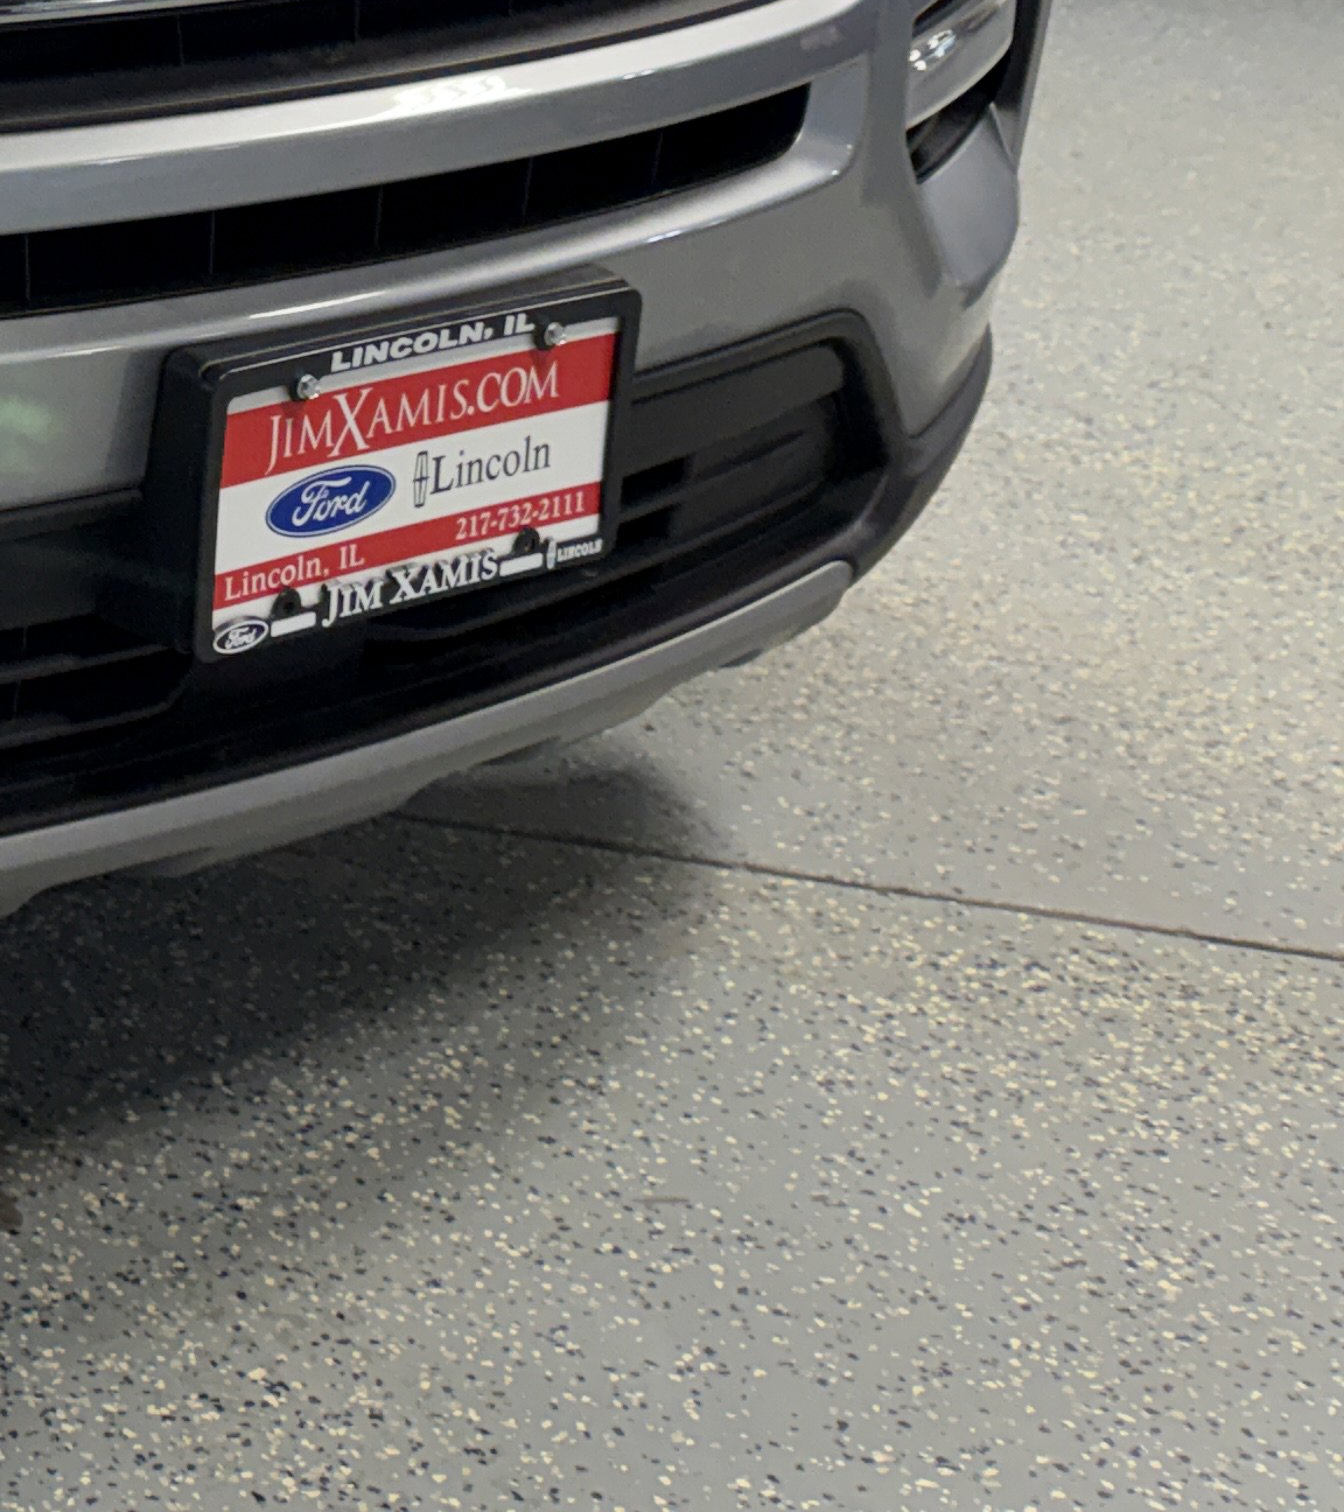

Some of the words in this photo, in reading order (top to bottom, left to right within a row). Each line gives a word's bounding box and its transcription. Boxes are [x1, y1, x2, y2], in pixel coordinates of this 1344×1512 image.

[331, 321, 493, 373] LINCOLN,
[503, 312, 535, 335] IL
[264, 361, 560, 476] JIMXAMIS.COM
[430, 436, 551, 495] Lincoln
[291, 476, 370, 526] Ford
[455, 491, 586, 540] 217-732-2111
[224, 555, 329, 601] Lincoln,
[339, 544, 366, 571] IL
[322, 578, 384, 627] JIM
[389, 552, 499, 602] XAMIS
